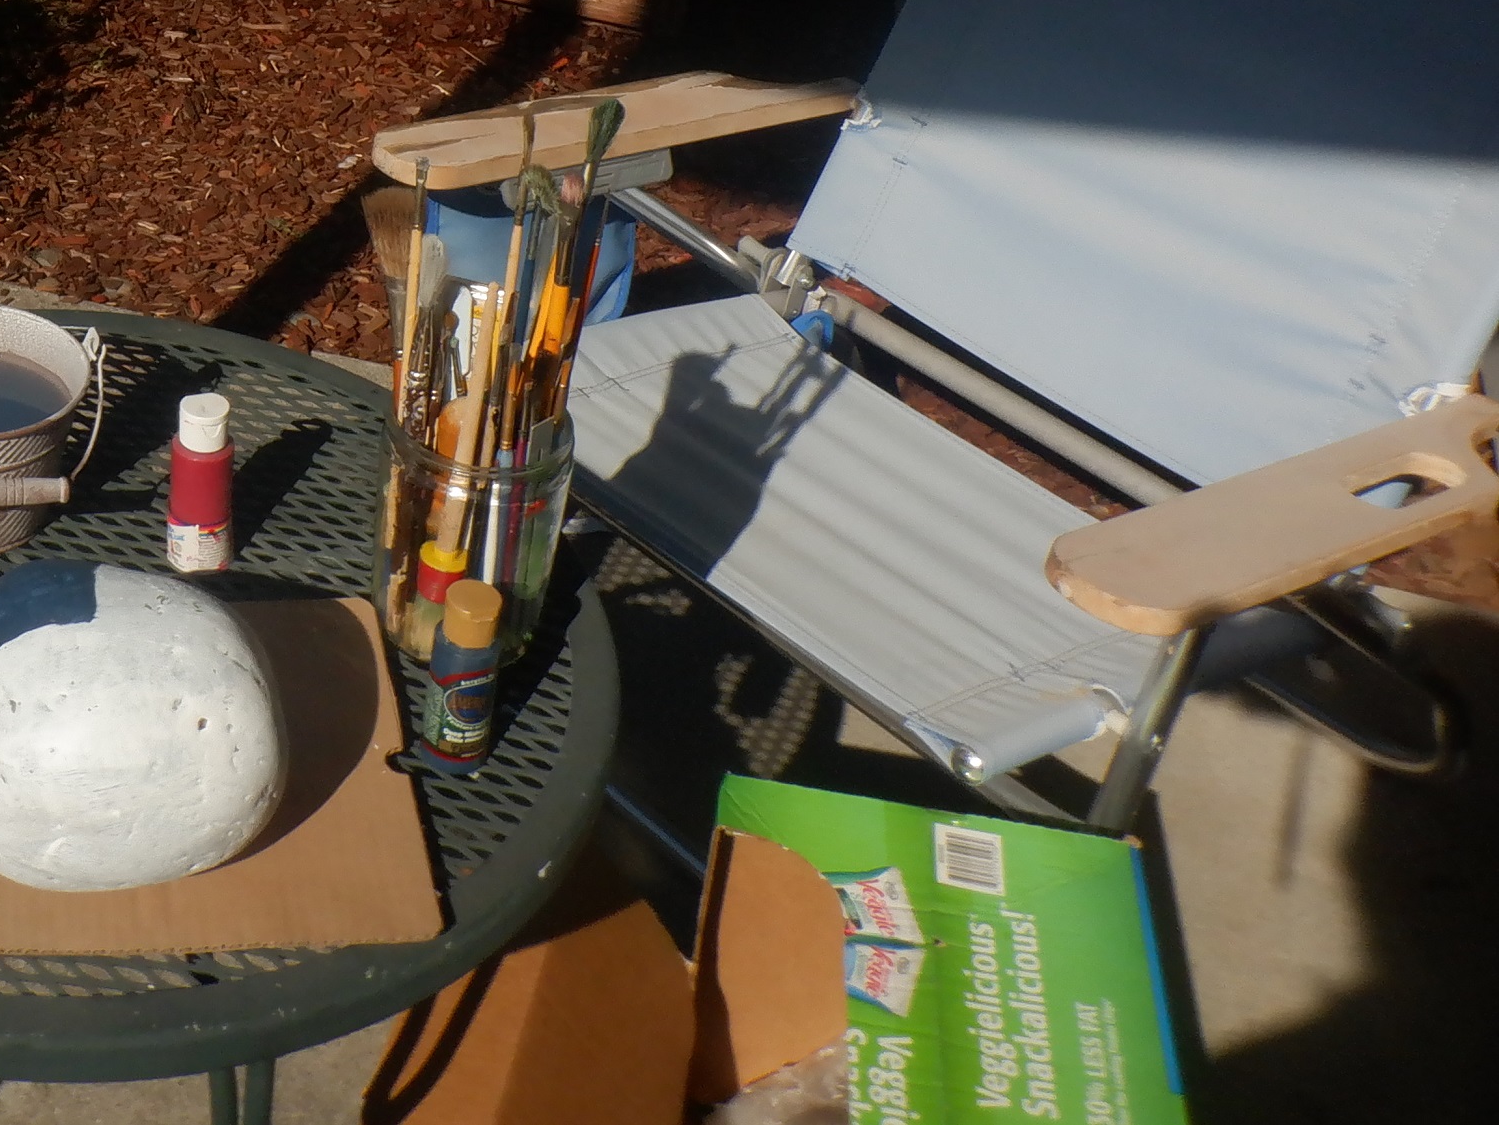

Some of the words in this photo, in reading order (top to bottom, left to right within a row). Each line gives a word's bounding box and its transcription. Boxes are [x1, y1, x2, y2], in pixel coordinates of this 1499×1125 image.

[962, 920, 1018, 1108] Veggielicious
[998, 909, 1062, 1119] Snackalicious!
[1074, 1001, 1102, 1032] FAT
[1079, 1035, 1104, 1077] LESS
